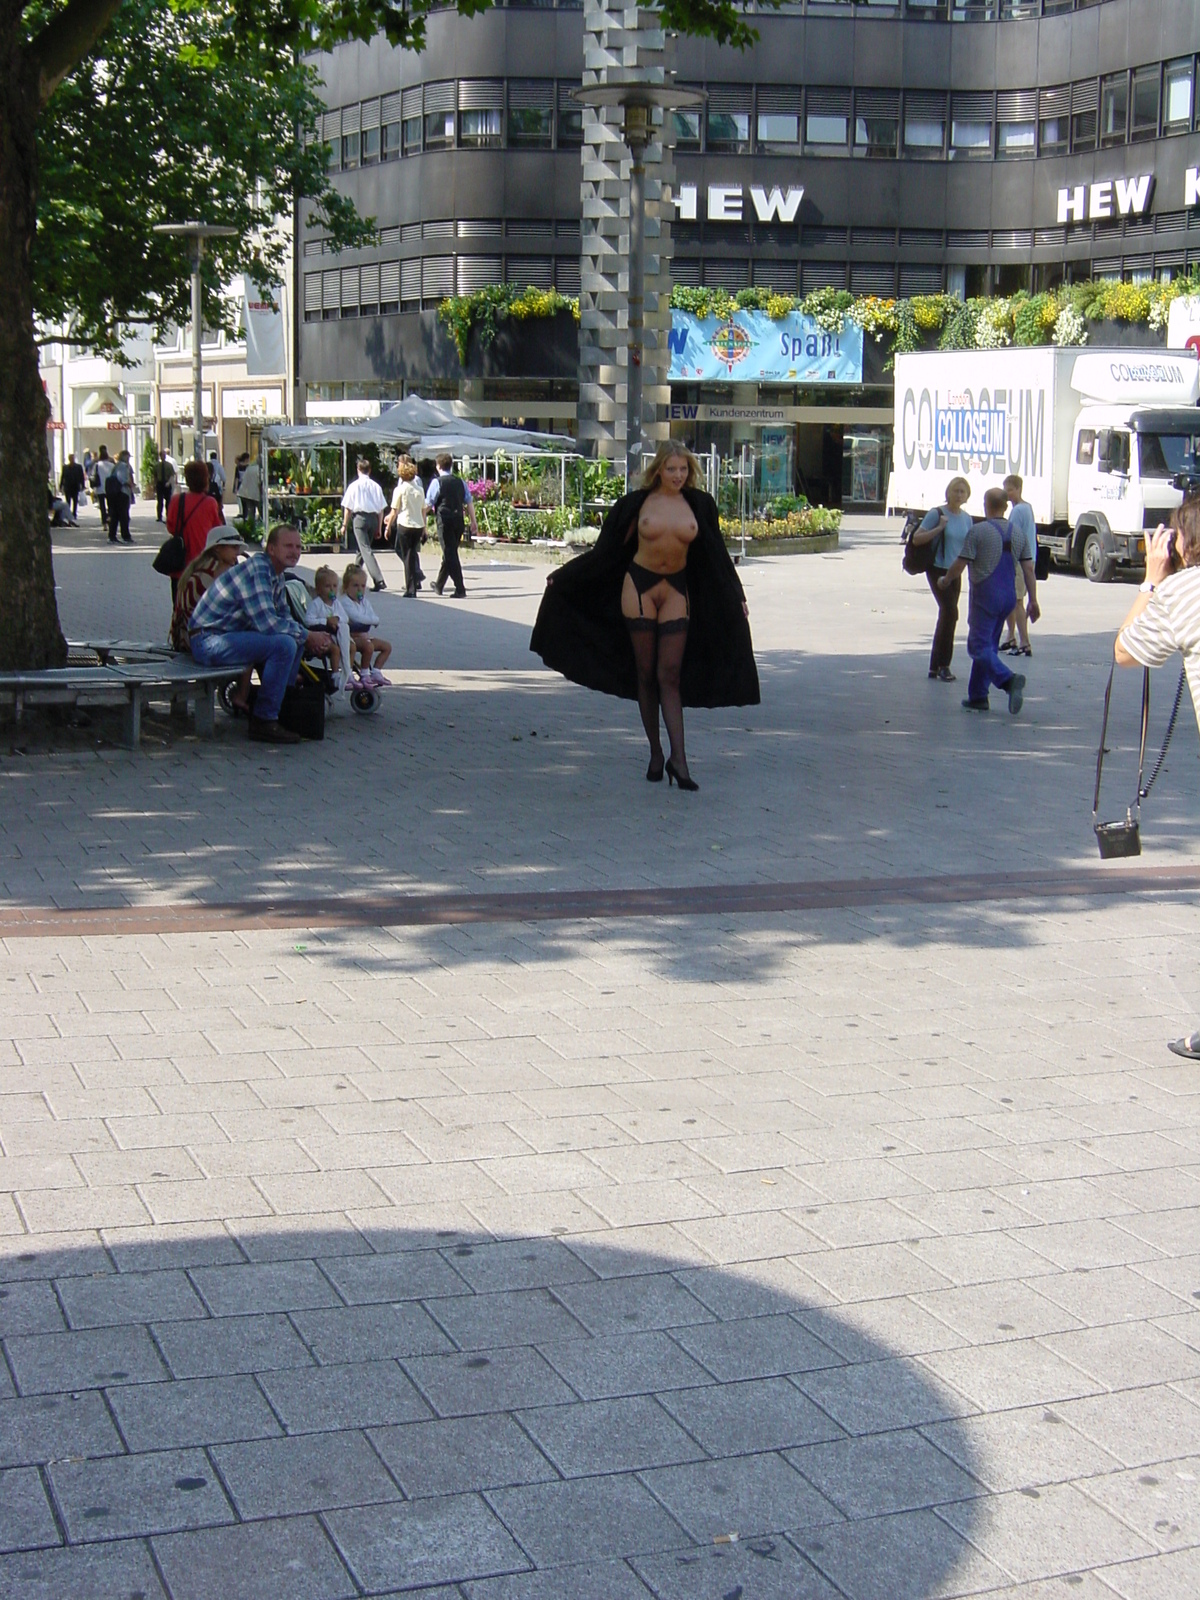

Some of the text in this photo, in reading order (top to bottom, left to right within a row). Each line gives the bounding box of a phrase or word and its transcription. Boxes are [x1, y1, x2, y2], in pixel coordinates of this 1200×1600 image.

[671, 184, 804, 222] HEW
[1057, 175, 1151, 223] HEW
[709, 407, 784, 419] Kundenzentrum
[937, 410, 1003, 453] COLLOSEUM
